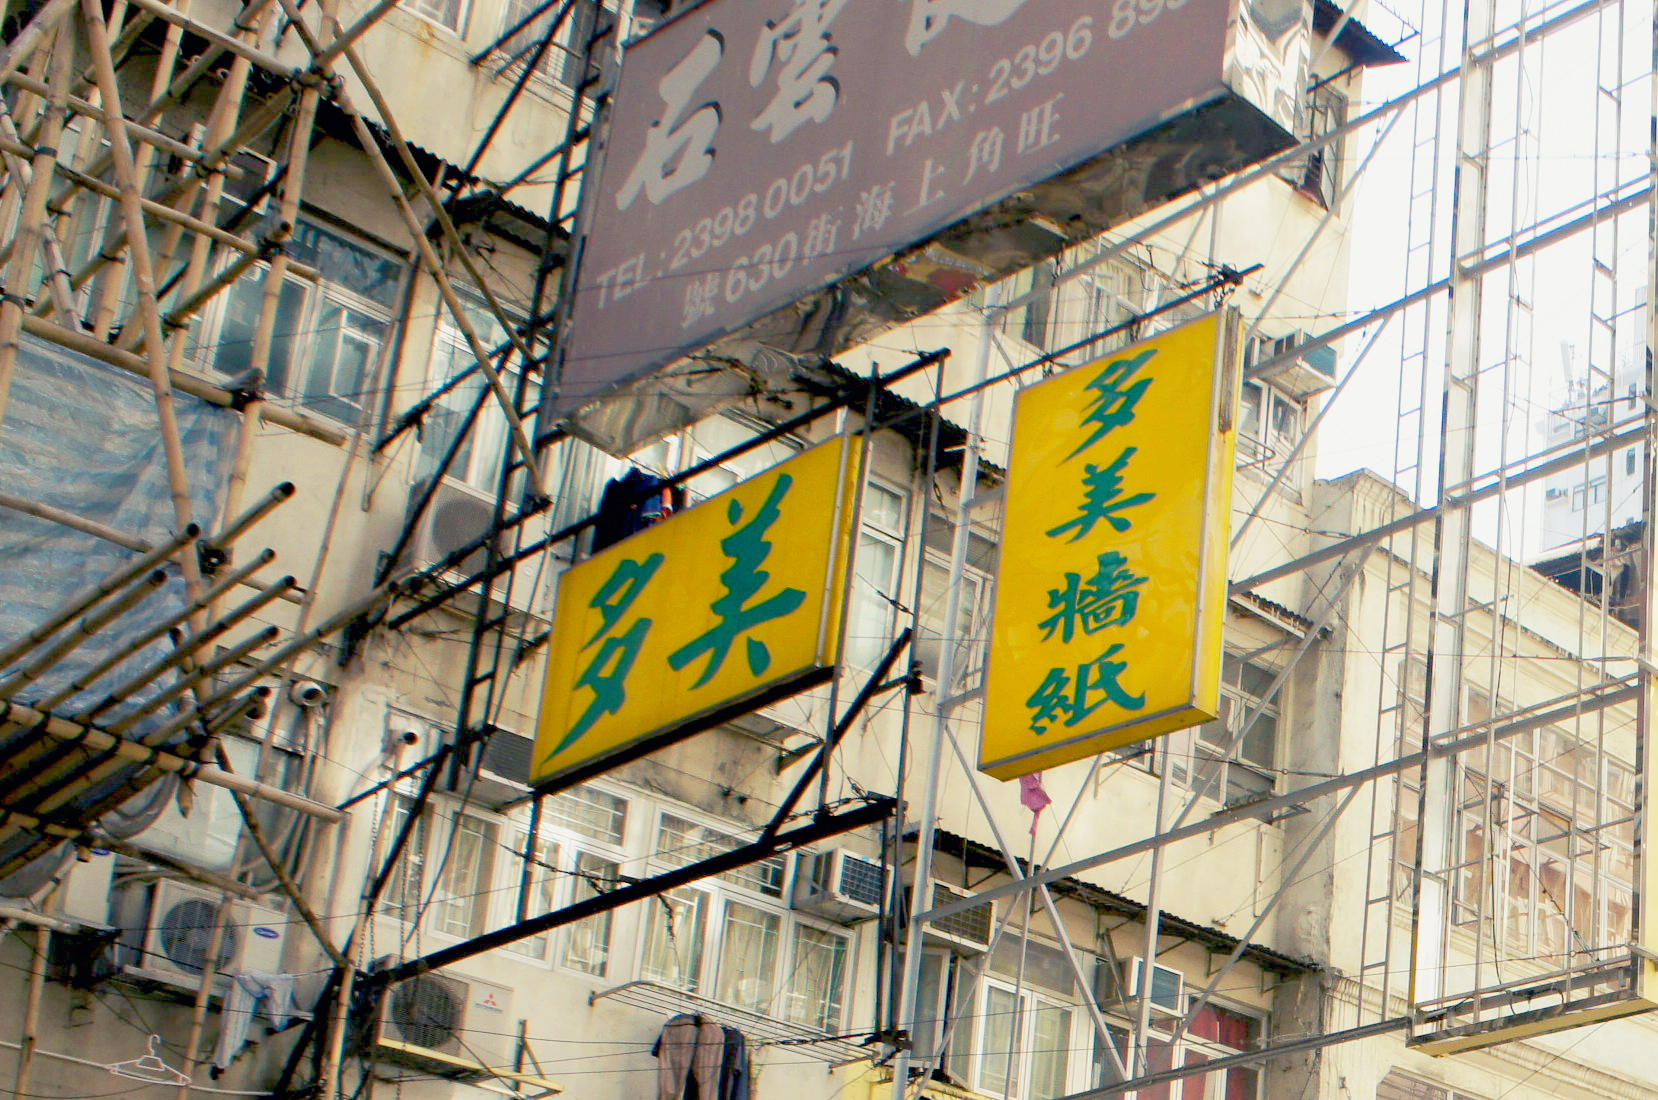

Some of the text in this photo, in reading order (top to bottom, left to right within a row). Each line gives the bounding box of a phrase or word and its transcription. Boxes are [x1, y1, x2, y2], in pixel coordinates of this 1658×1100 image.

[985, 15, 1094, 105] 2396
[1026, 348, 1157, 736] 多美牆紙
